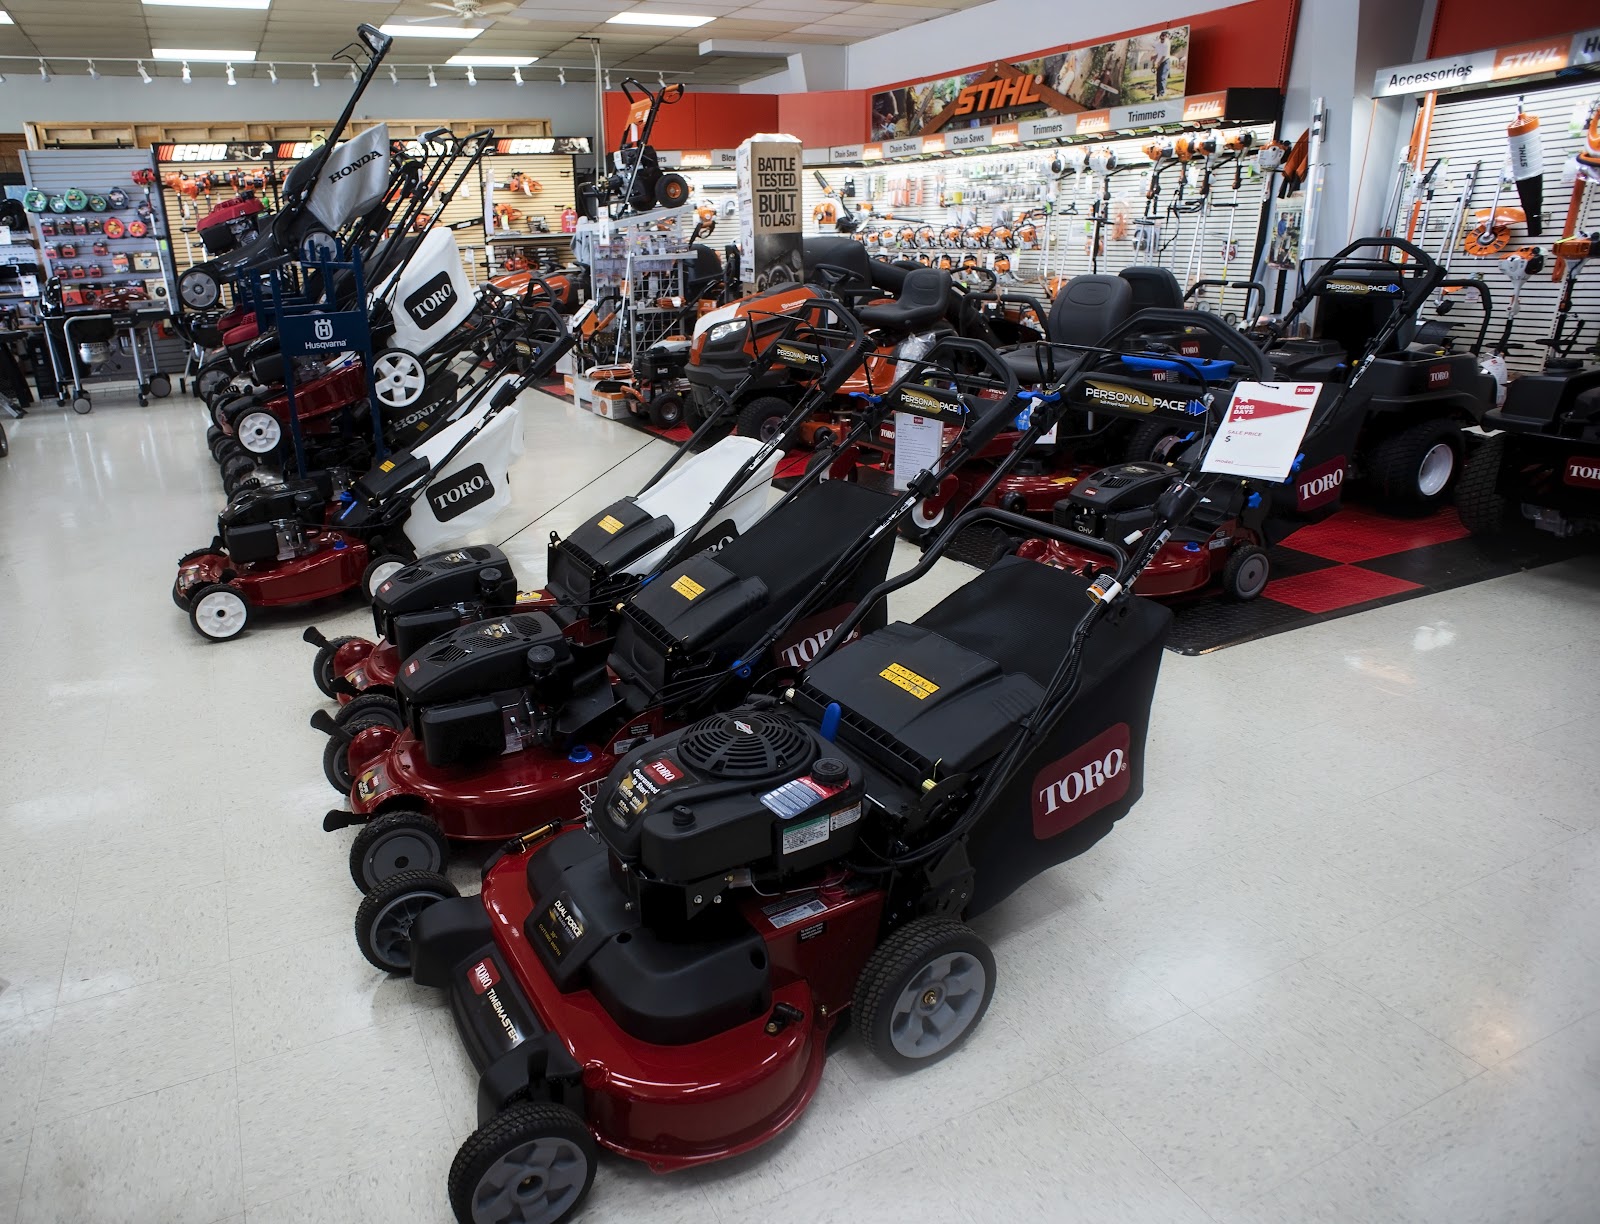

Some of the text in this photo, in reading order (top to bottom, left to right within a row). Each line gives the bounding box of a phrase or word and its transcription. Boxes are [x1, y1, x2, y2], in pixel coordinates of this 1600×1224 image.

[1583, 36, 1600, 54] H
[1500, 47, 1559, 68] STIHL
[1388, 63, 1474, 88] Accessories
[953, 74, 1041, 116] STIHL
[1128, 108, 1166, 122] Trimmers
[1187, 100, 1221, 114] STIHL
[1033, 124, 1062, 135] Trimmers
[1079, 116, 1106, 129] STIHL
[953, 134, 968, 144] Chain
[969, 132, 984, 143] Saws
[172, 144, 227, 160] ECHO
[722, 154, 736, 162] Blow
[890, 144, 902, 154] Chain
[904, 144, 916, 152] Saws
[1518, 144, 1528, 168] STIHL
[328, 150, 383, 184] HONDA
[758, 157, 796, 172] BATTLE
[758, 173, 796, 187] TESTED
[758, 194, 796, 213] BUILT
[759, 214, 796, 227] TO LAST
[412, 282, 452, 320] TORO
[305, 340, 346, 350] Husqvarna
[1182, 346, 1198, 354] TORO
[776, 348, 804, 359] PERSONAL
[804, 354, 819, 363] PACE
[1152, 372, 1166, 381] TO
[1430, 370, 1450, 382] TORO
[900, 394, 937, 408] PERSONAL
[940, 402, 958, 413] PACE
[1086, 388, 1188, 412] PERSONAL PACE
[393, 397, 452, 432] HOND
[1569, 464, 1600, 480] TOR
[433, 475, 485, 510] TORO
[1299, 468, 1344, 500] TORO
[1078, 526, 1093, 535] OHV
[781, 622, 856, 668] TOR
[632, 768, 660, 794] Guaranteed
[652, 762, 676, 782] TORO
[1040, 748, 1124, 816] TORO
[554, 900, 582, 938] DUAL FORCE
[475, 962, 520, 1044] TORO TIMEMASTER
